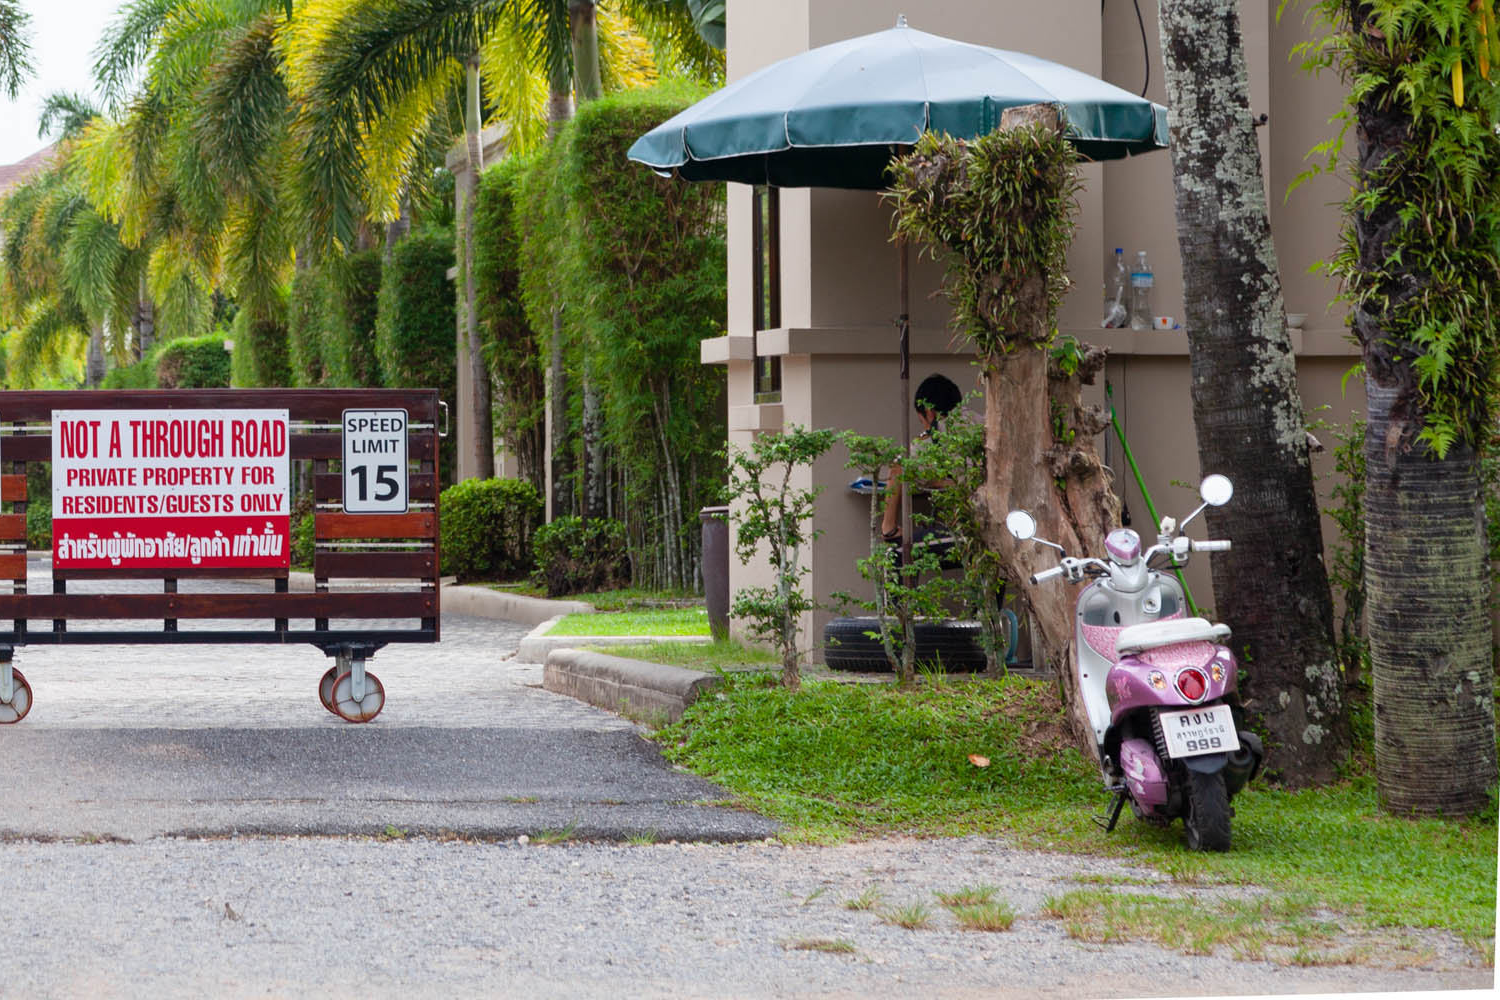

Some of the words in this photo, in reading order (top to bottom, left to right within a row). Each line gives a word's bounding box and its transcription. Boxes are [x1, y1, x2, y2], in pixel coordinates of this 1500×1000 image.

[348, 418, 403, 432] SPEED
[60, 420, 101, 458] NOT
[109, 420, 122, 458] A
[129, 419, 224, 458] THROUGH
[232, 419, 286, 458] ROAD
[352, 439, 400, 453] LIMIT
[67, 468, 137, 487] PRIVATE
[143, 466, 235, 486] PROPERTY
[241, 466, 275, 485] FOR
[350, 465, 399, 501] 15
[62, 494, 234, 515] RESIDENTS/GUESTS
[241, 493, 284, 513] ONLY
[57, 530, 230, 566] สำหรับผู้พักอาศัย/ลูกค้า
[232, 521, 284, 557] เท่านั้น
[1186, 737, 1221, 752] 999
